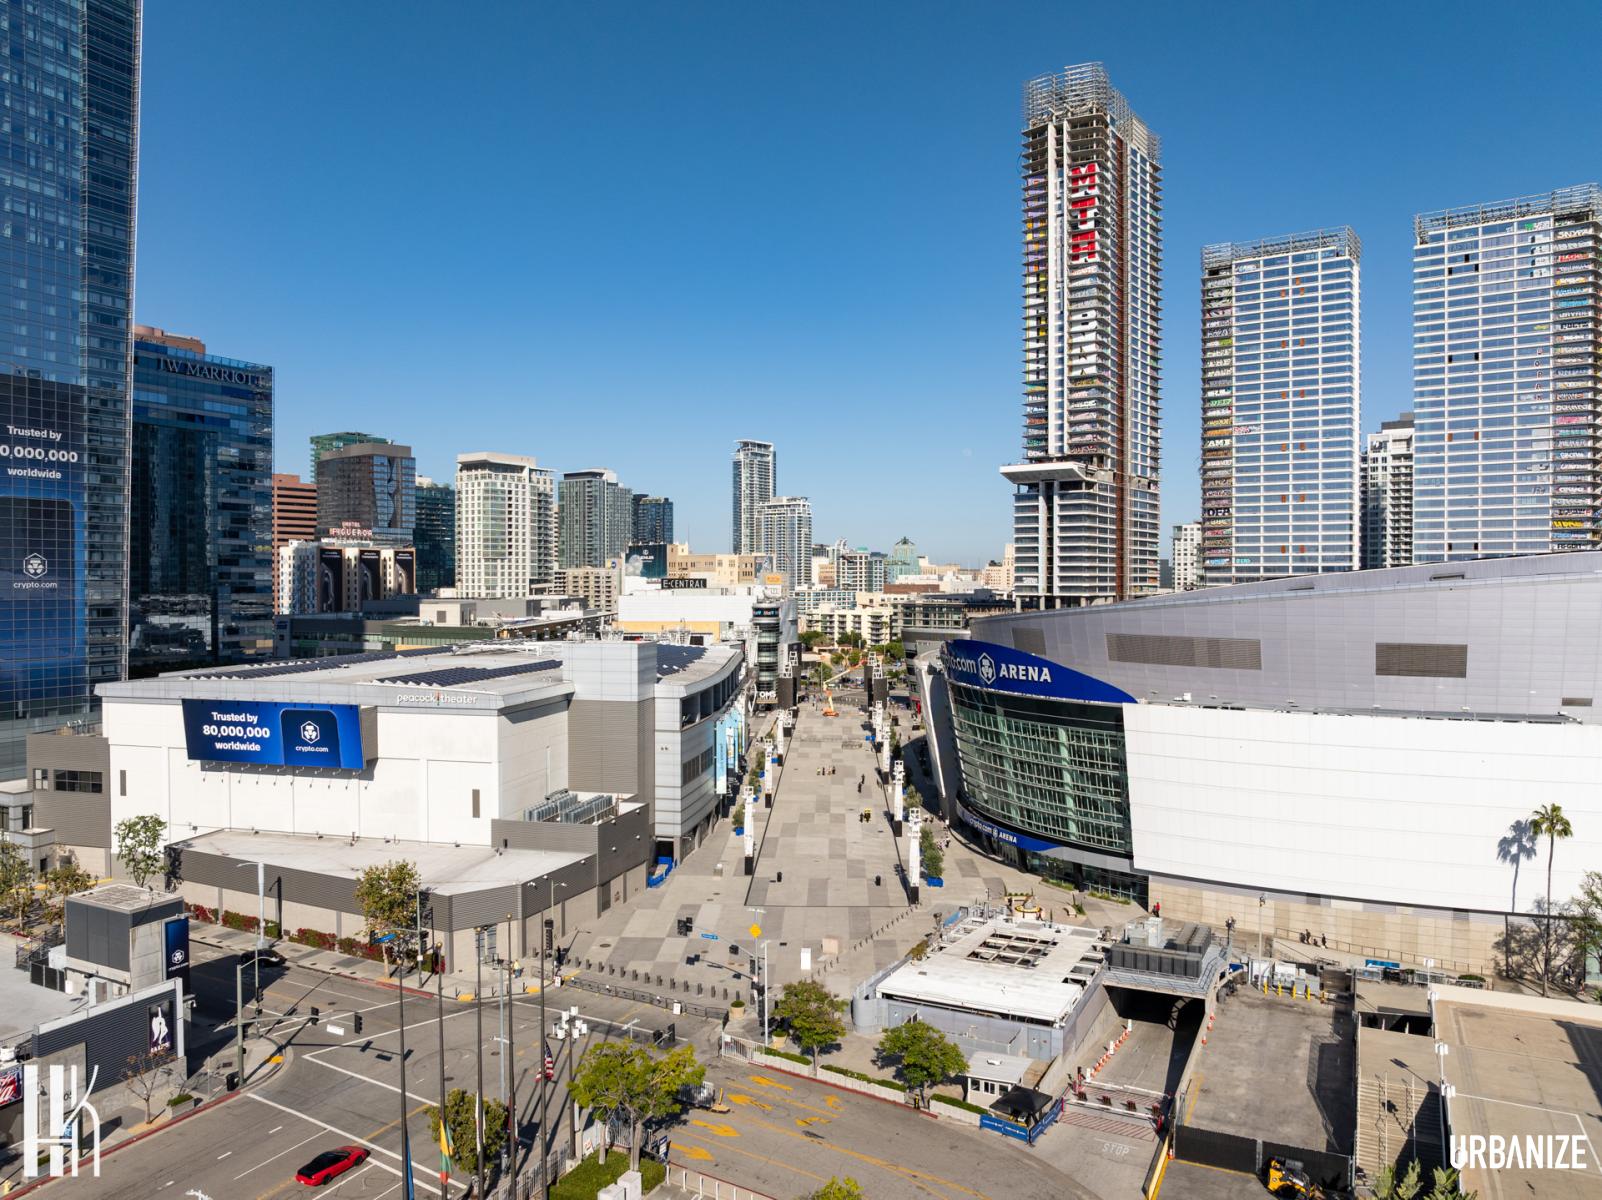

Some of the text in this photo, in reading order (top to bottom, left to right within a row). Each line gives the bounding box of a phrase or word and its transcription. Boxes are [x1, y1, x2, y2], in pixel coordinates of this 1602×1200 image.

[6, 425, 62, 441] Trusted by
[7, 468, 62, 479] worldwide
[1000, 663, 1052, 683] ARENA
[396, 693, 478, 705] peacock theater
[211, 711, 258, 724] Trusted by
[202, 725, 271, 739] 80,000,000
[215, 741, 261, 752] worldwide
[295, 745, 329, 753] crypto.com
[998, 831, 1018, 844] ARENA
[1102, 1142, 1130, 1157] STOP
